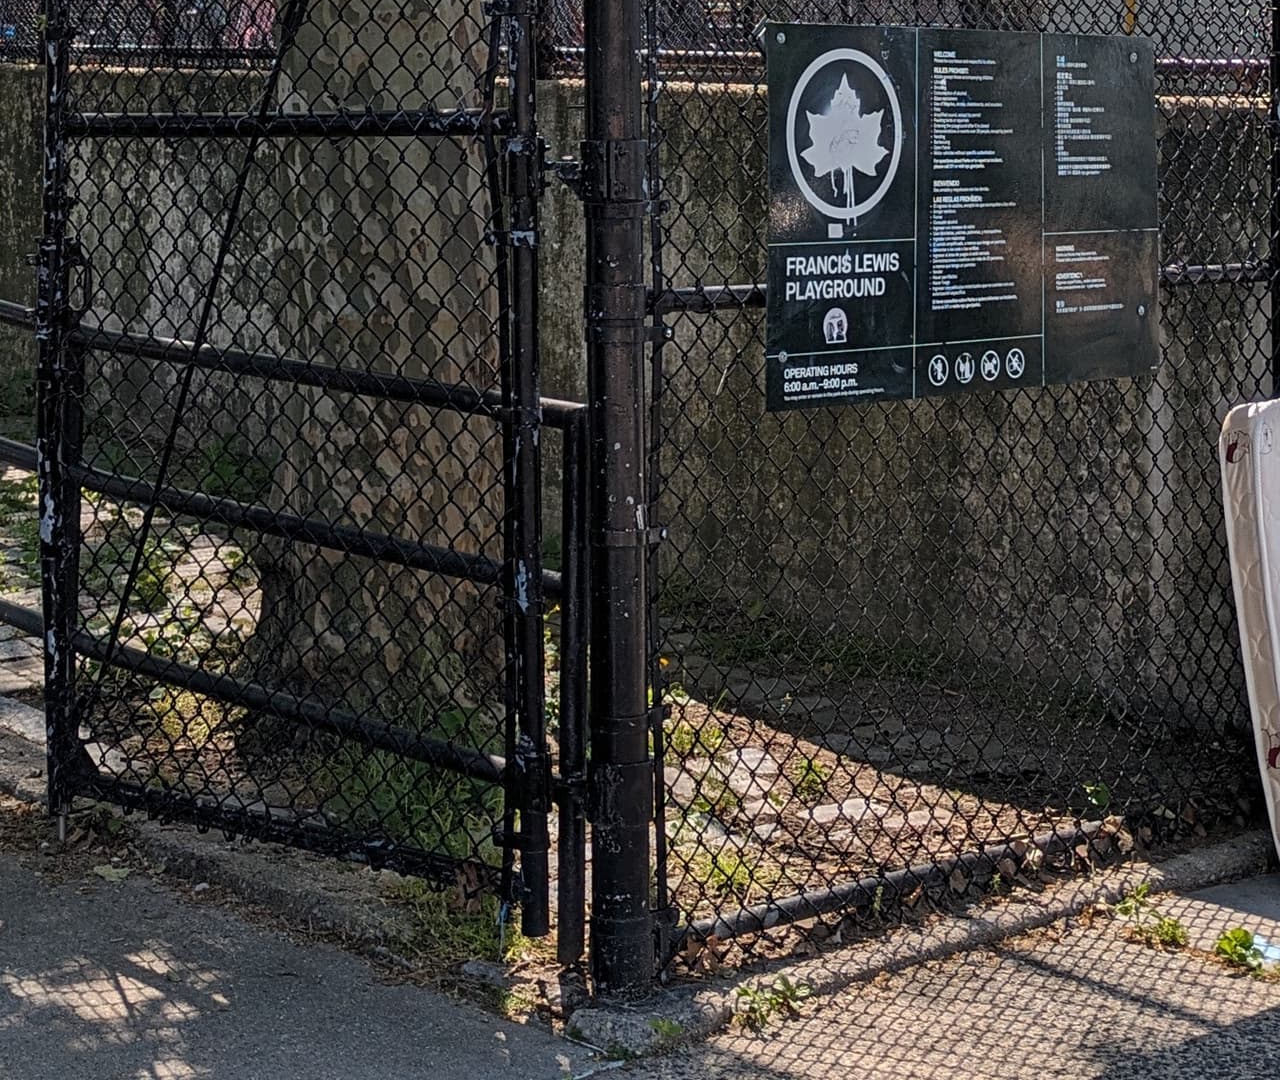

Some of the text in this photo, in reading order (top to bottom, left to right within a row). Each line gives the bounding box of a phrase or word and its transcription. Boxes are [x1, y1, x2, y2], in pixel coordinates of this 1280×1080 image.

[786, 253, 900, 276] FRANCIS LEWIS
[785, 277, 886, 301] PLAYGROUND
[784, 363, 858, 379] OPERATING HOURS
[784, 381, 801, 392] 6:00
[841, 378, 858, 390] p.m.
